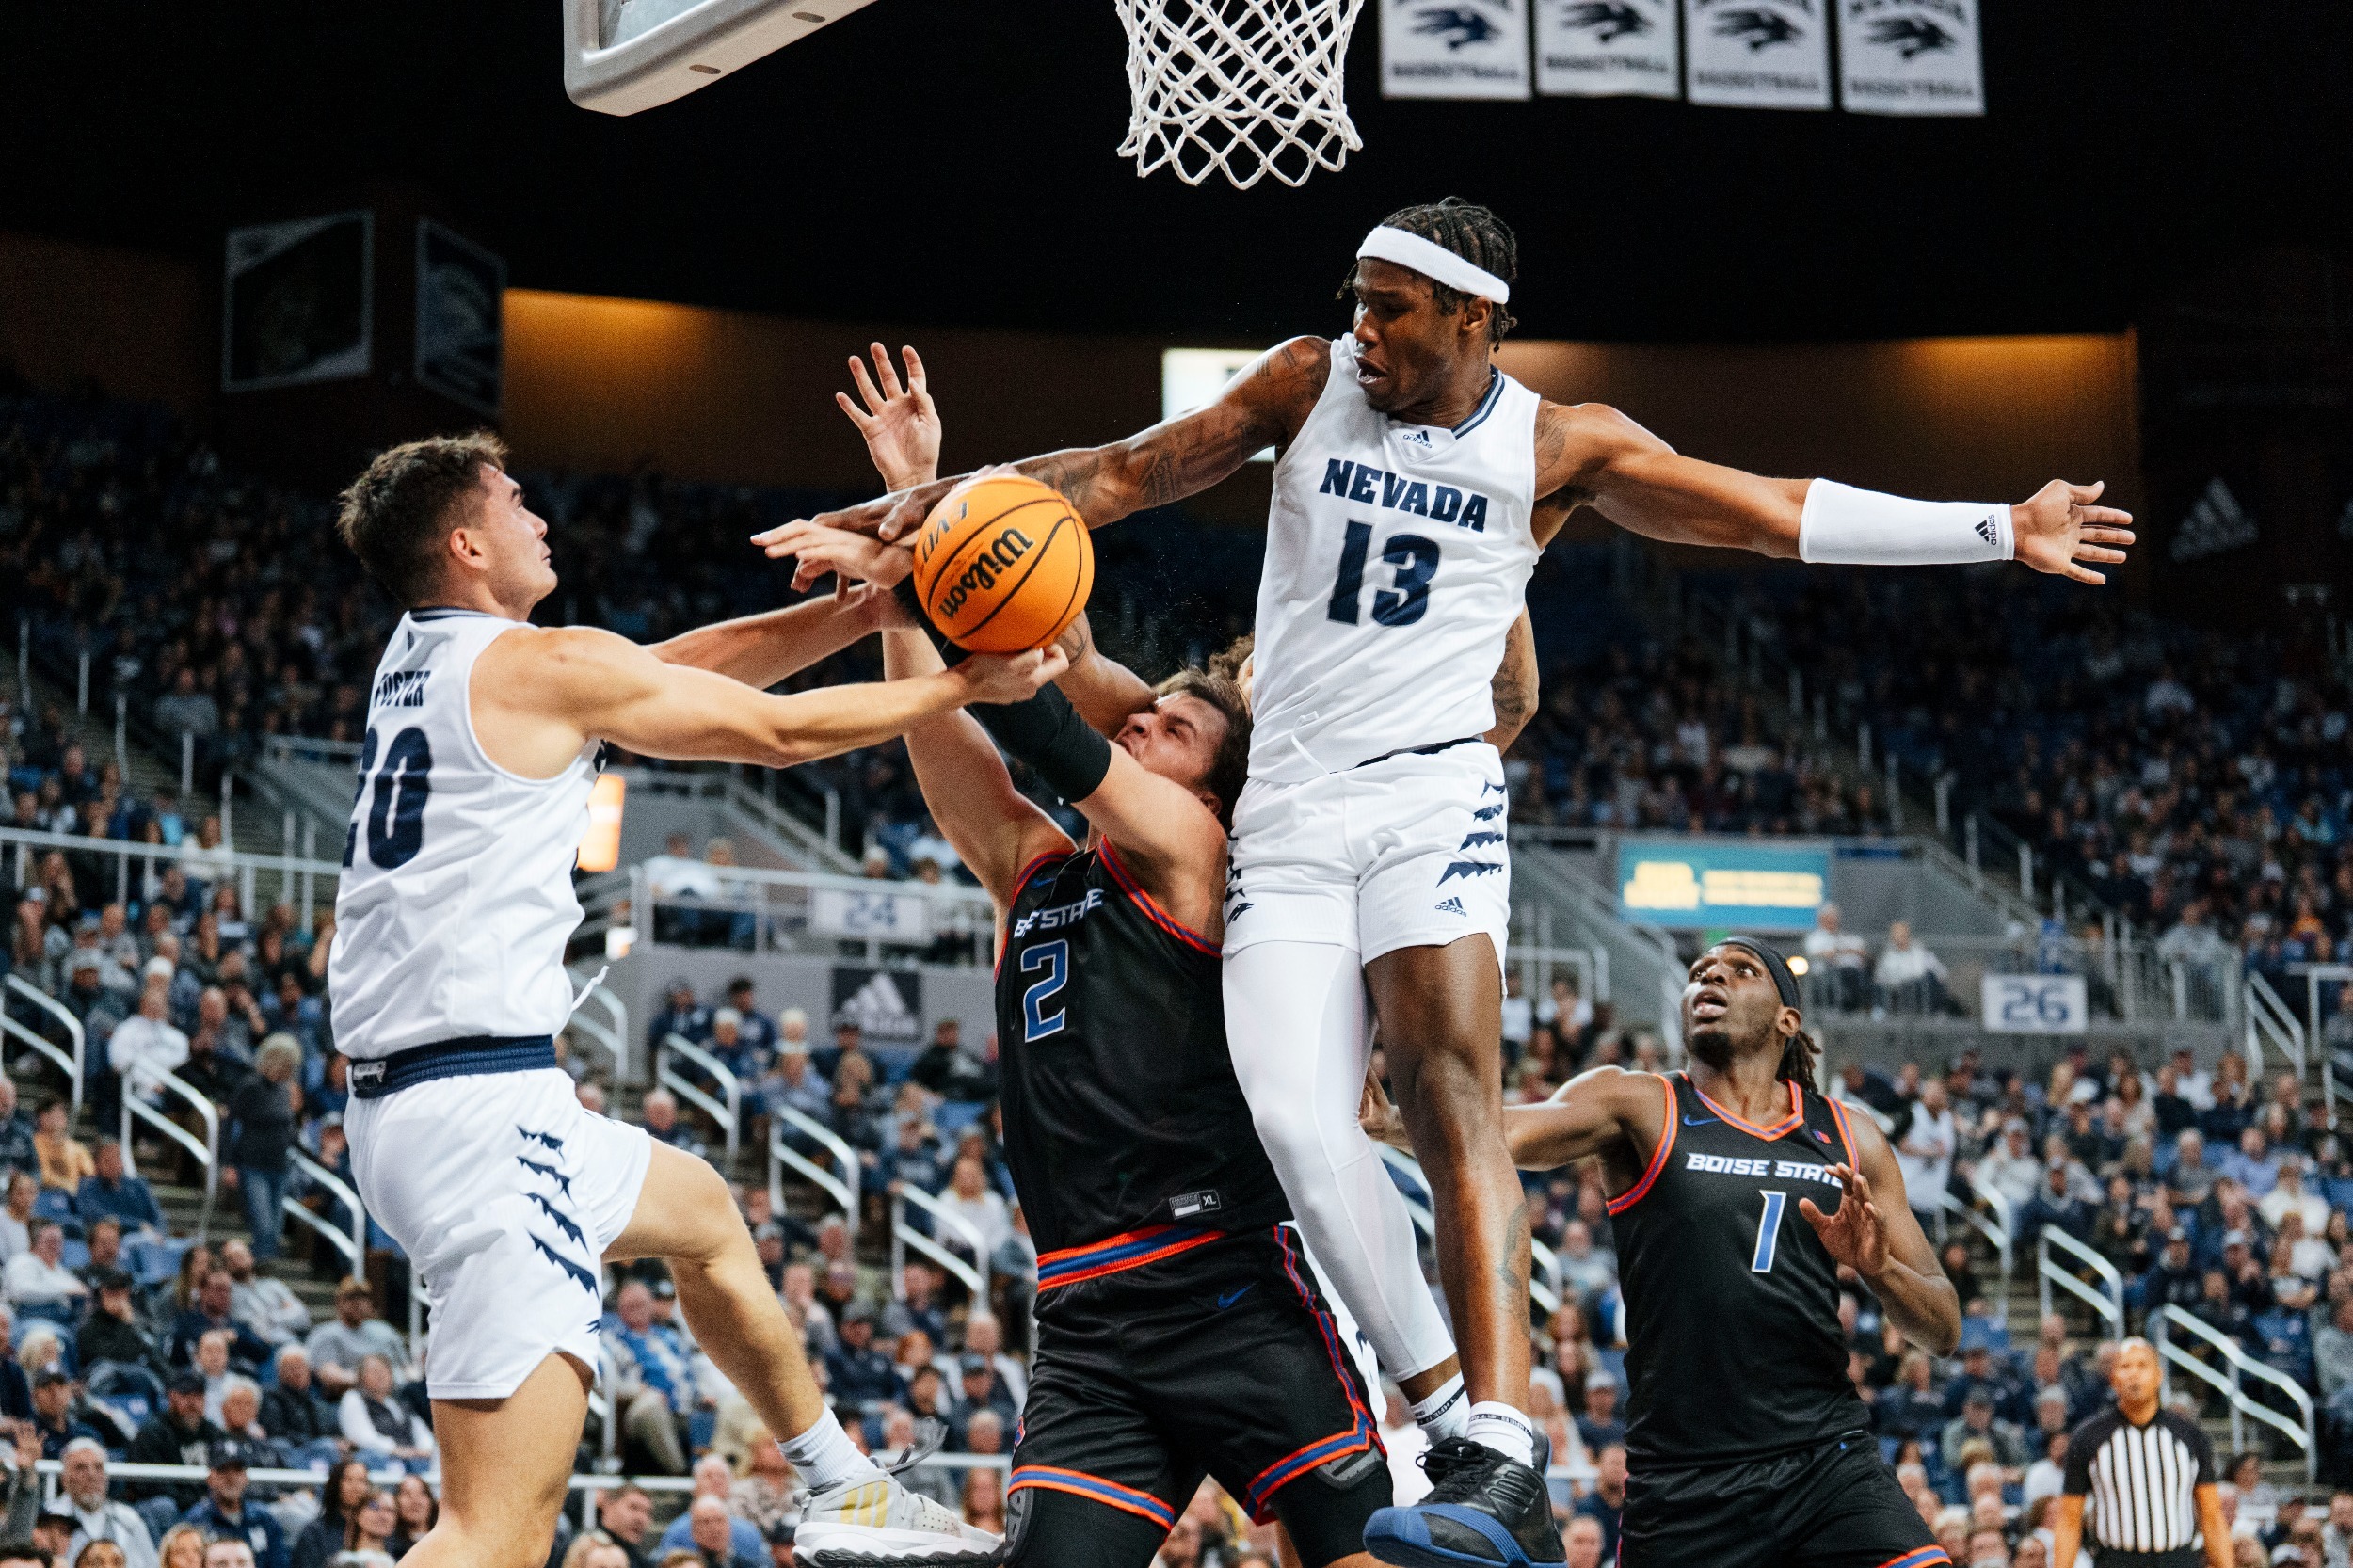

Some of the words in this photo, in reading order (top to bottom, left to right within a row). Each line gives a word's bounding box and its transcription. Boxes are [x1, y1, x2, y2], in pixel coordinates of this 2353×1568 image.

[1402, 433, 1433, 449] adidas
[1319, 457, 1489, 533] NEVADA
[1988, 514, 1997, 545] adidas
[938, 527, 1034, 619] Wilson
[1326, 518, 1442, 627] 13
[1434, 904, 1467, 917] adidas
[1020, 938, 1069, 1043] 2
[2002, 982, 2069, 1029] 26
[1685, 1152, 1770, 1176] BOISE
[1202, 1194, 1216, 1206] XL
[1751, 1190, 1786, 1273] 1
